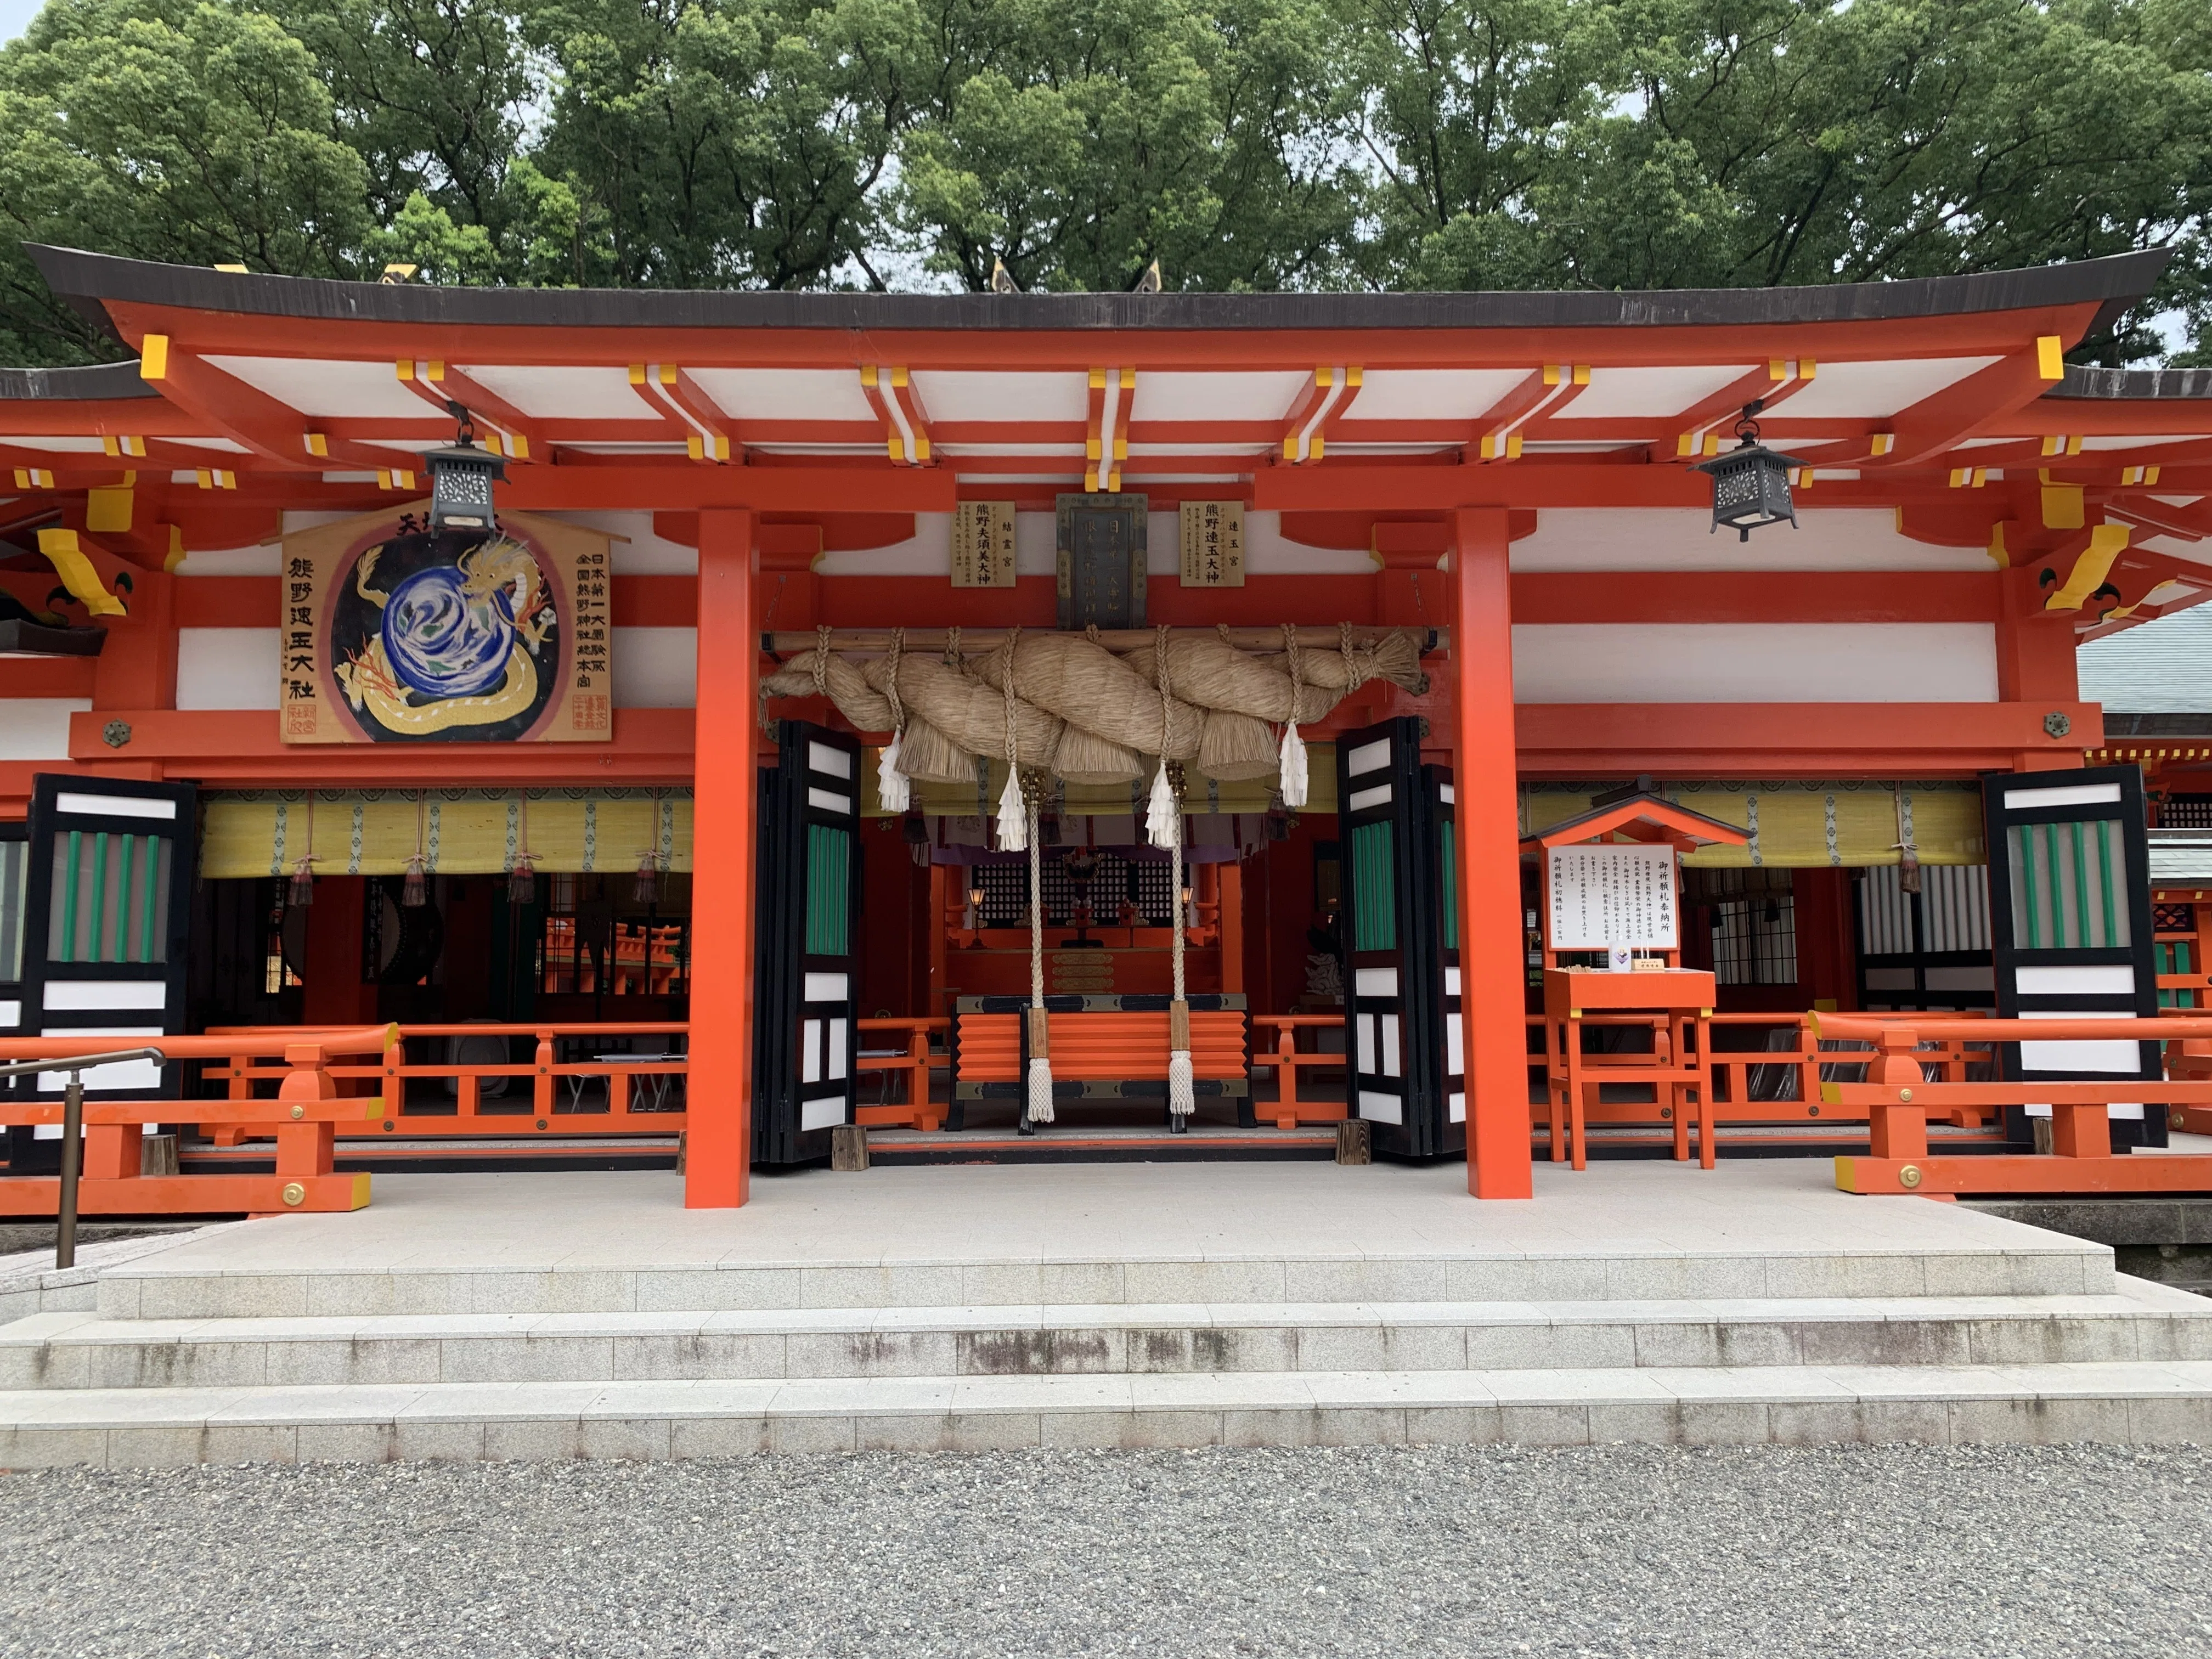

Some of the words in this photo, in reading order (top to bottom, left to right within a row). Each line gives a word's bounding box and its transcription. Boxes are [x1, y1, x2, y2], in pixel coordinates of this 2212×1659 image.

[976, 503, 990, 585] 熊野夫須美大神
[1205, 503, 1220, 584] 熊野速玉大神
[1228, 521, 1239, 567] 速玉宮
[287, 557, 315, 699] 熊野速玉大社
[1658, 861, 1671, 933] 御祈願札奉納所
